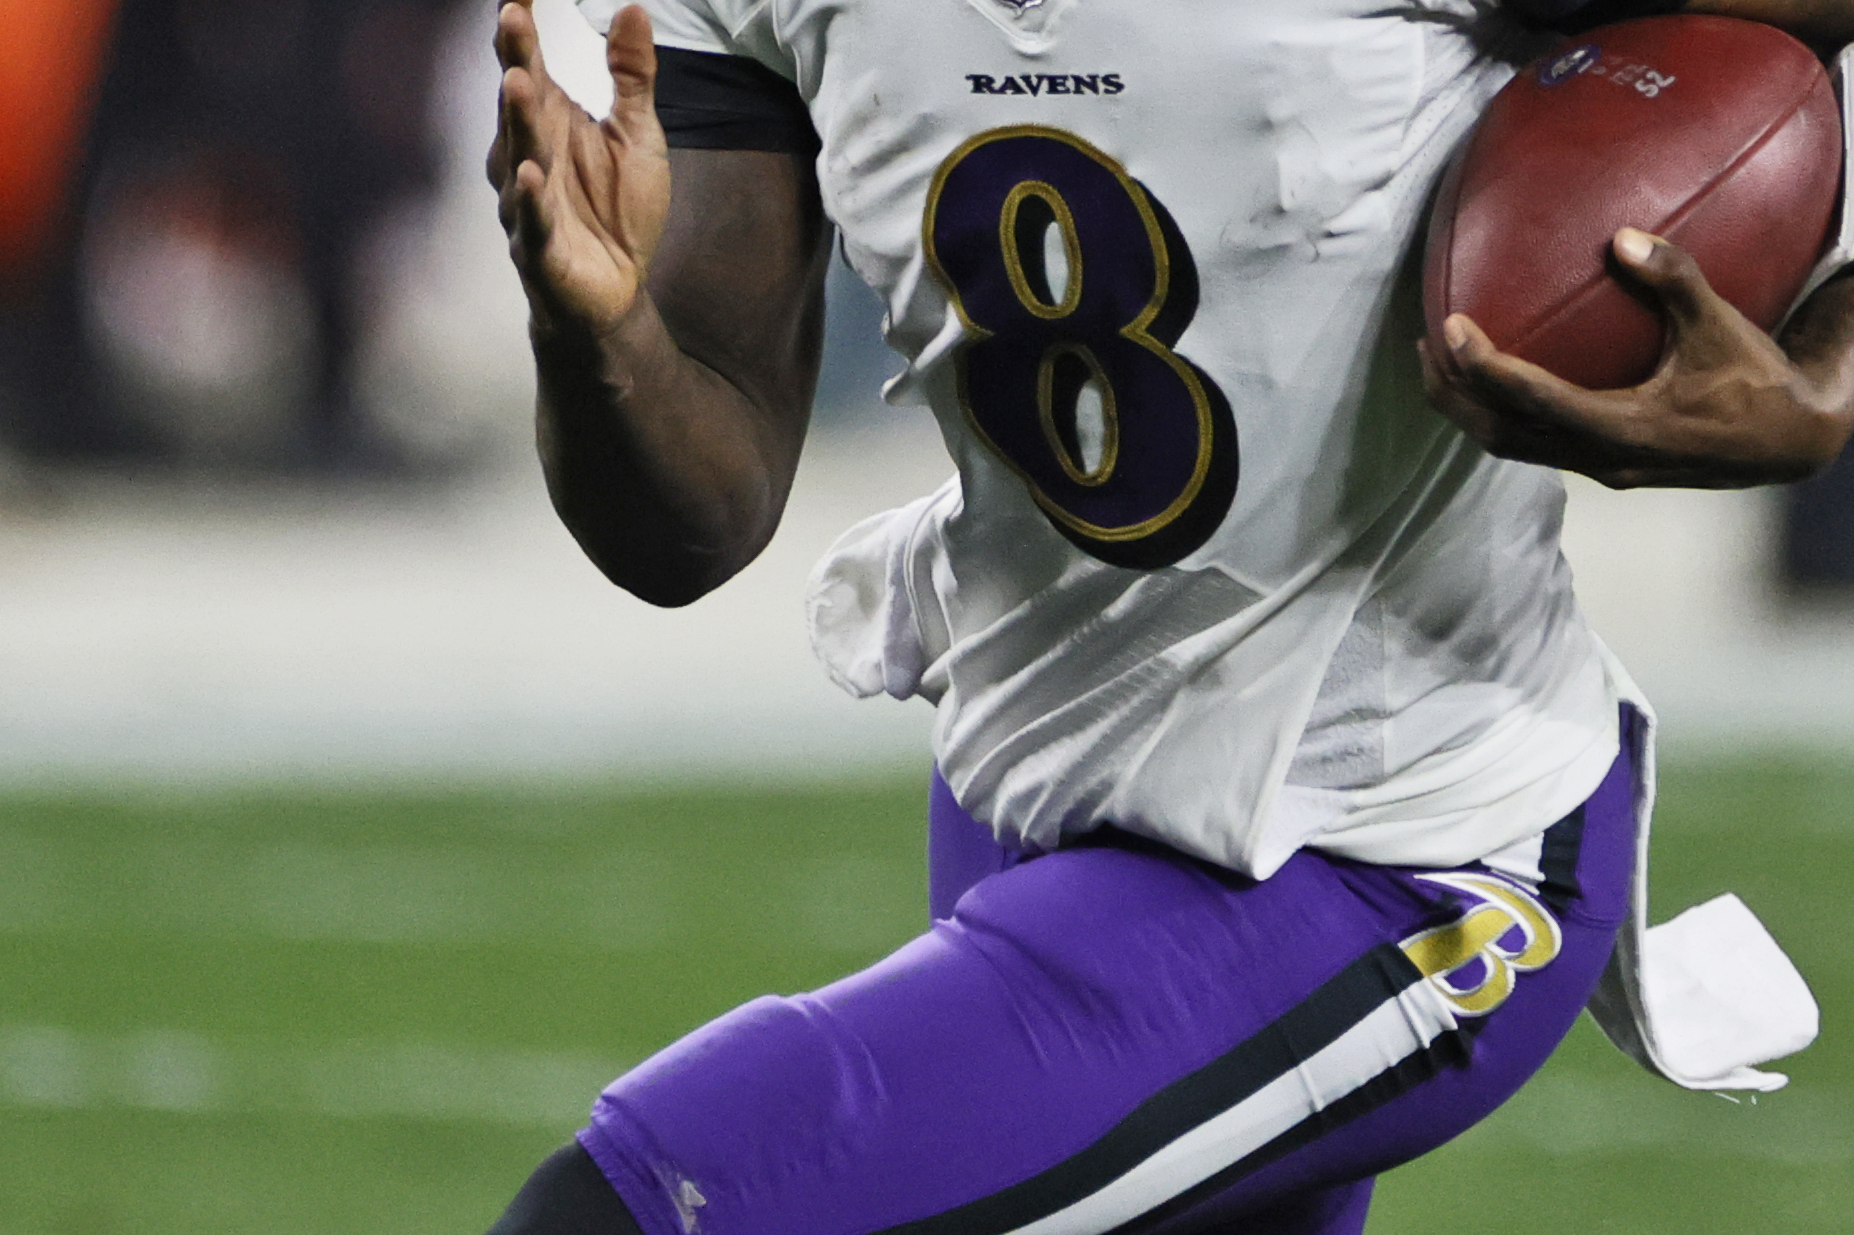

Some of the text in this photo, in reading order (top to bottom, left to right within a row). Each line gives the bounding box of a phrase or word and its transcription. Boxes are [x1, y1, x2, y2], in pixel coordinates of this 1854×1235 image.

[966, 73, 1126, 98] RAVENS
[1634, 69, 1677, 99] 52
[921, 122, 1241, 571] 8
